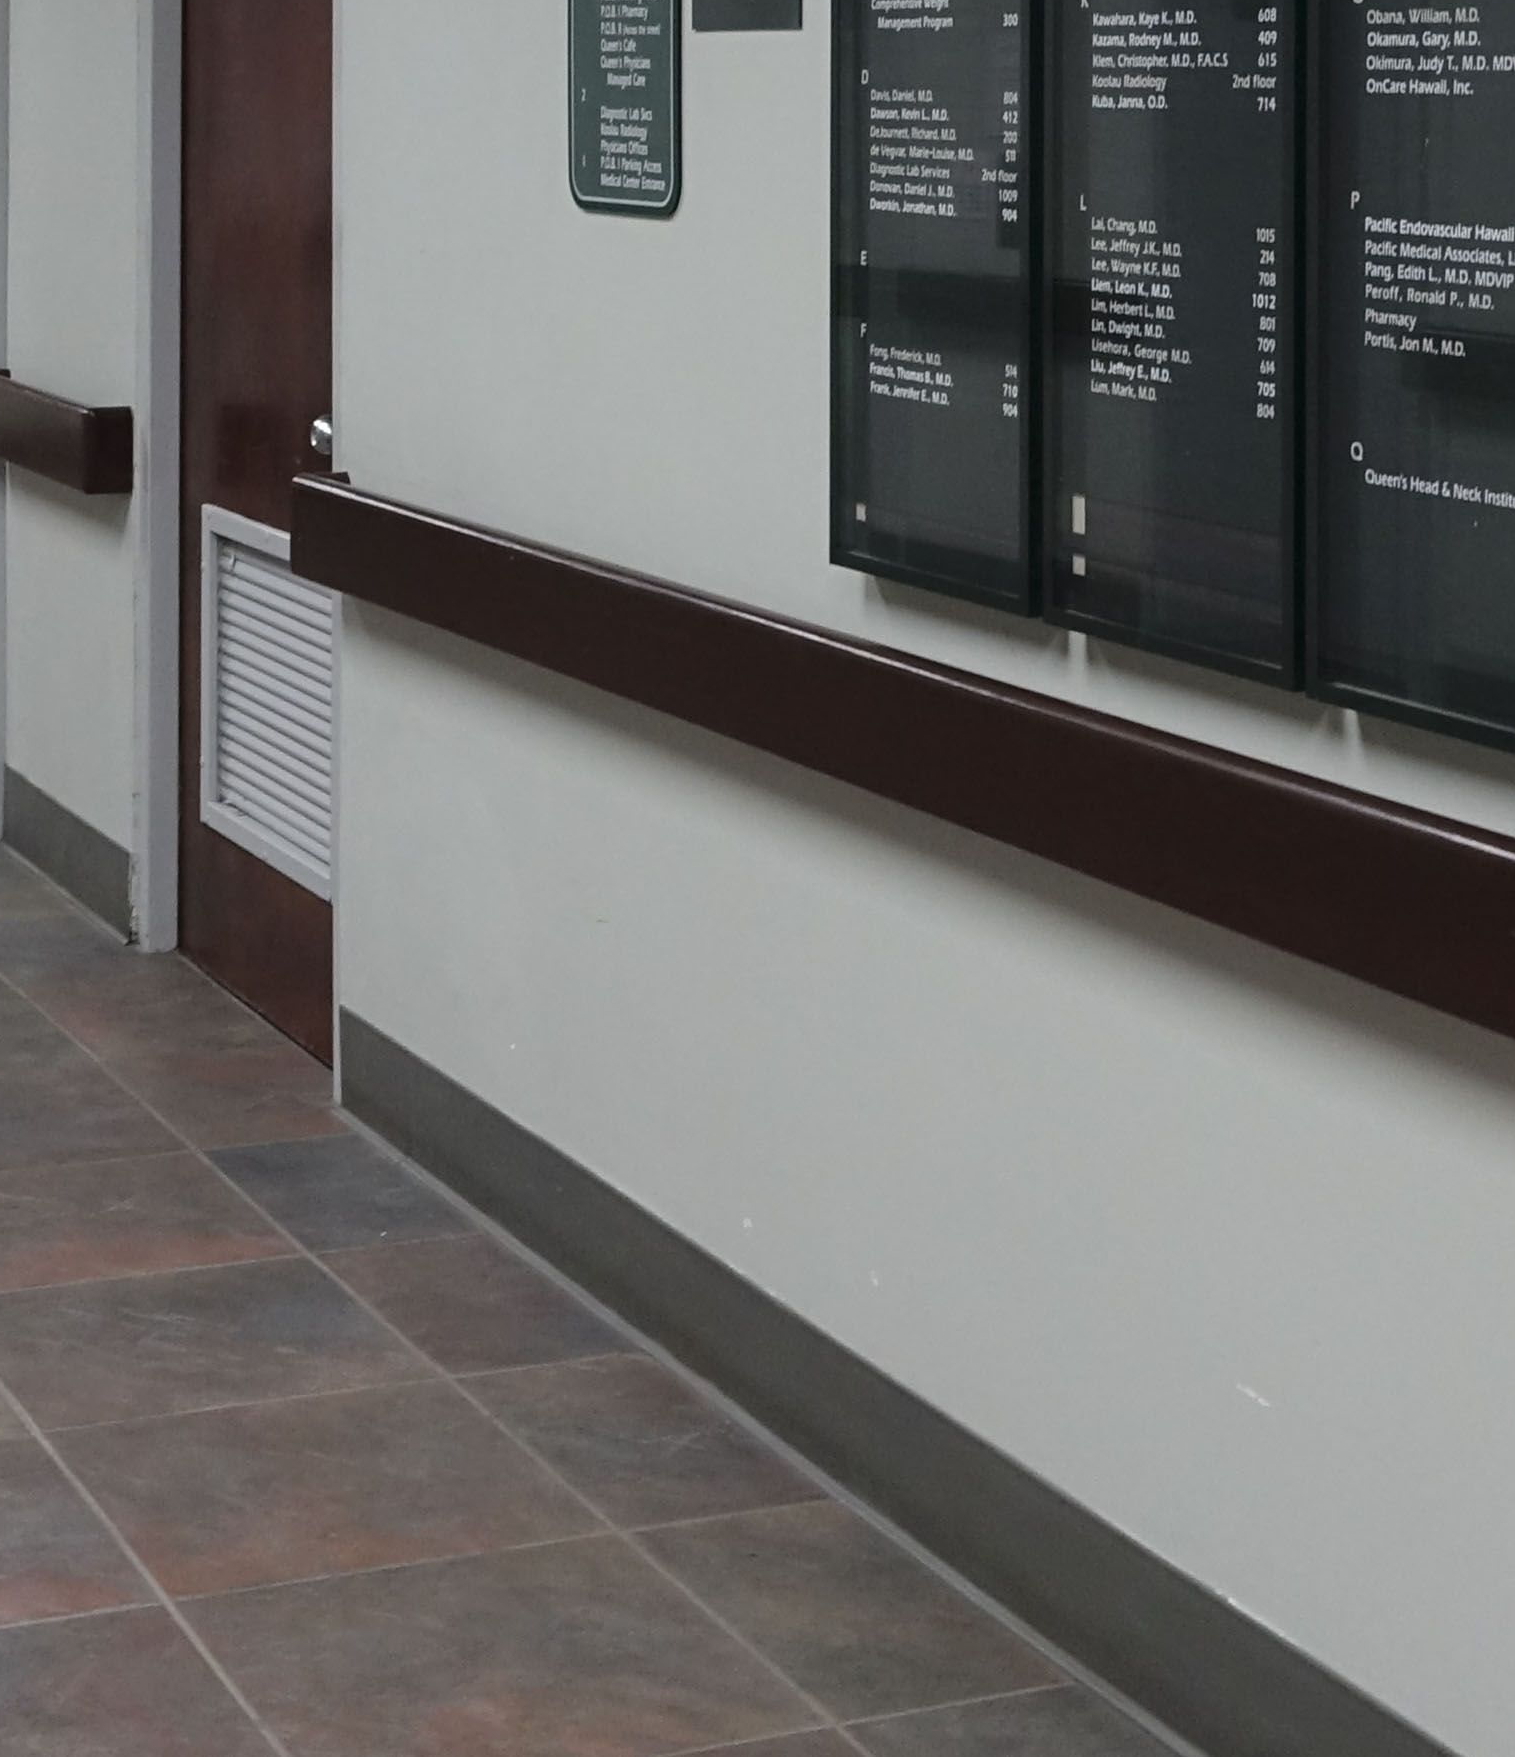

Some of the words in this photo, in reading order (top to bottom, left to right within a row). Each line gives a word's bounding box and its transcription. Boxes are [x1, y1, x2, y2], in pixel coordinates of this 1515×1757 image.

[622, 7, 648, 21] Pharmacy
[877, 16, 922, 31] Management
[601, 39, 622, 53] Queen's
[861, 69, 868, 84] D
[1366, 78, 1406, 93] OnCare
[1453, 79, 1473, 95] Inc.
[1080, 195, 1087, 211] L
[1351, 191, 1360, 209] P
[1365, 216, 1397, 233] Pacific
[1399, 219, 1472, 239] Endovascular
[1365, 308, 1416, 332] Pharmacy
[1150, 366, 1171, 382] M.D.
[1257, 381, 1275, 397] 705
[1365, 468, 1407, 490] Queen's
[1410, 476, 1439, 495] Head
[1441, 481, 1450, 497] &
[1453, 483, 1481, 502] Neck
